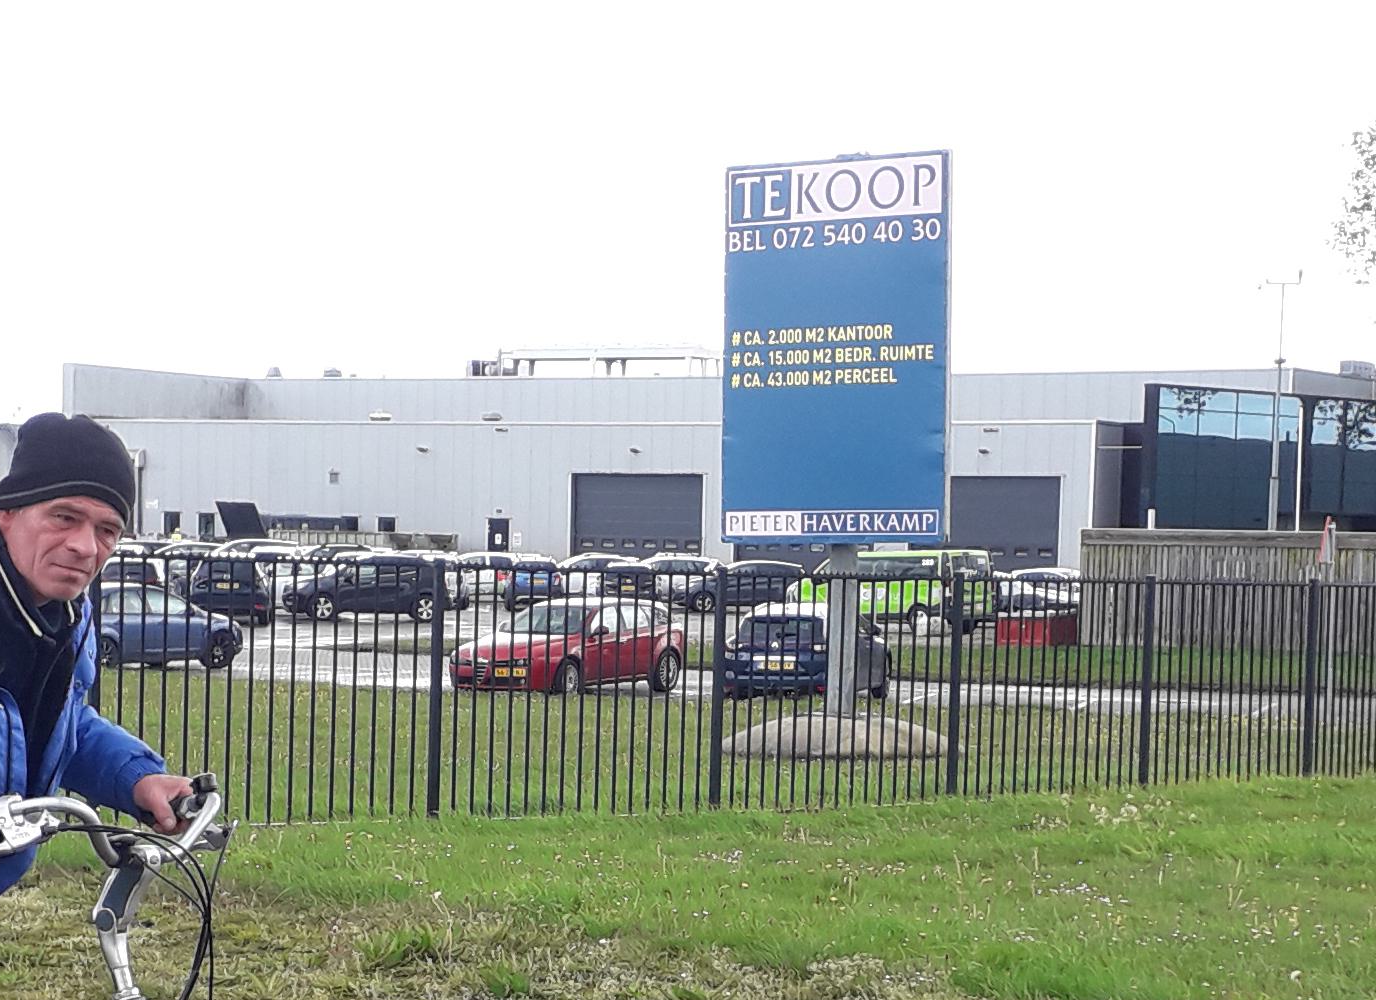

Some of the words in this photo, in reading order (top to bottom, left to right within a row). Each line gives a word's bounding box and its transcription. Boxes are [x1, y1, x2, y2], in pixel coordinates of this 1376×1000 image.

[735, 175, 786, 220] TE
[796, 164, 937, 215] KOOP
[728, 229, 766, 253] BEL
[773, 226, 815, 250] 072
[823, 222, 866, 246] 540
[873, 219, 903, 243] 40
[911, 217, 941, 241] 30
[731, 331, 741, 347] #
[743, 331, 765, 346] CA.
[768, 328, 803, 345] 2.000
[805, 327, 824, 343] M2
[827, 324, 893, 342] KANTOOR
[731, 352, 741, 368] #
[743, 352, 765, 367] CA.
[768, 349, 809, 366] 15.000
[812, 348, 832, 364] M2
[835, 346, 876, 363] BEDR.
[880, 344, 935, 361] RUIMTE
[731, 373, 740, 389] #
[743, 373, 765, 388] CA.
[767, 371, 809, 387] 43.000
[812, 370, 832, 385] M2
[834, 367, 898, 384] PERCEEL
[729, 514, 797, 532] PIETER
[803, 513, 935, 533] HAVERKAMP
